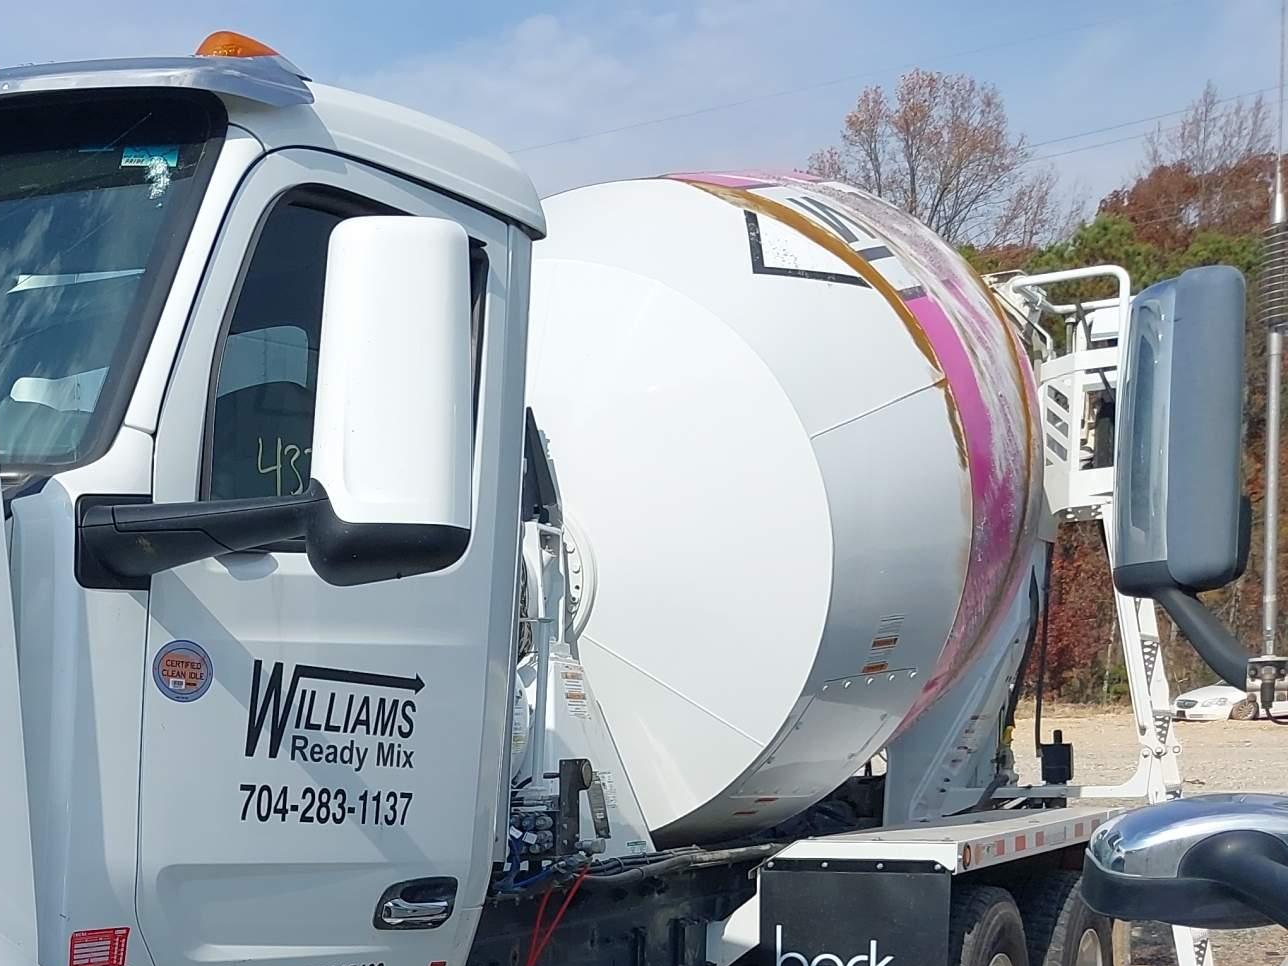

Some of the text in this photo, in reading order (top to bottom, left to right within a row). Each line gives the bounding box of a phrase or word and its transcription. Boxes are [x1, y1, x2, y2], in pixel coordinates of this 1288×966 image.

[257, 437, 312, 496] 43
[161, 668, 205, 681] CLEAN IDLE
[165, 659, 202, 670] CERTIFIED
[245, 659, 417, 759] WILLIAMS
[290, 735, 415, 771] Ready Mix
[239, 784, 413, 826] 704-283-1137
